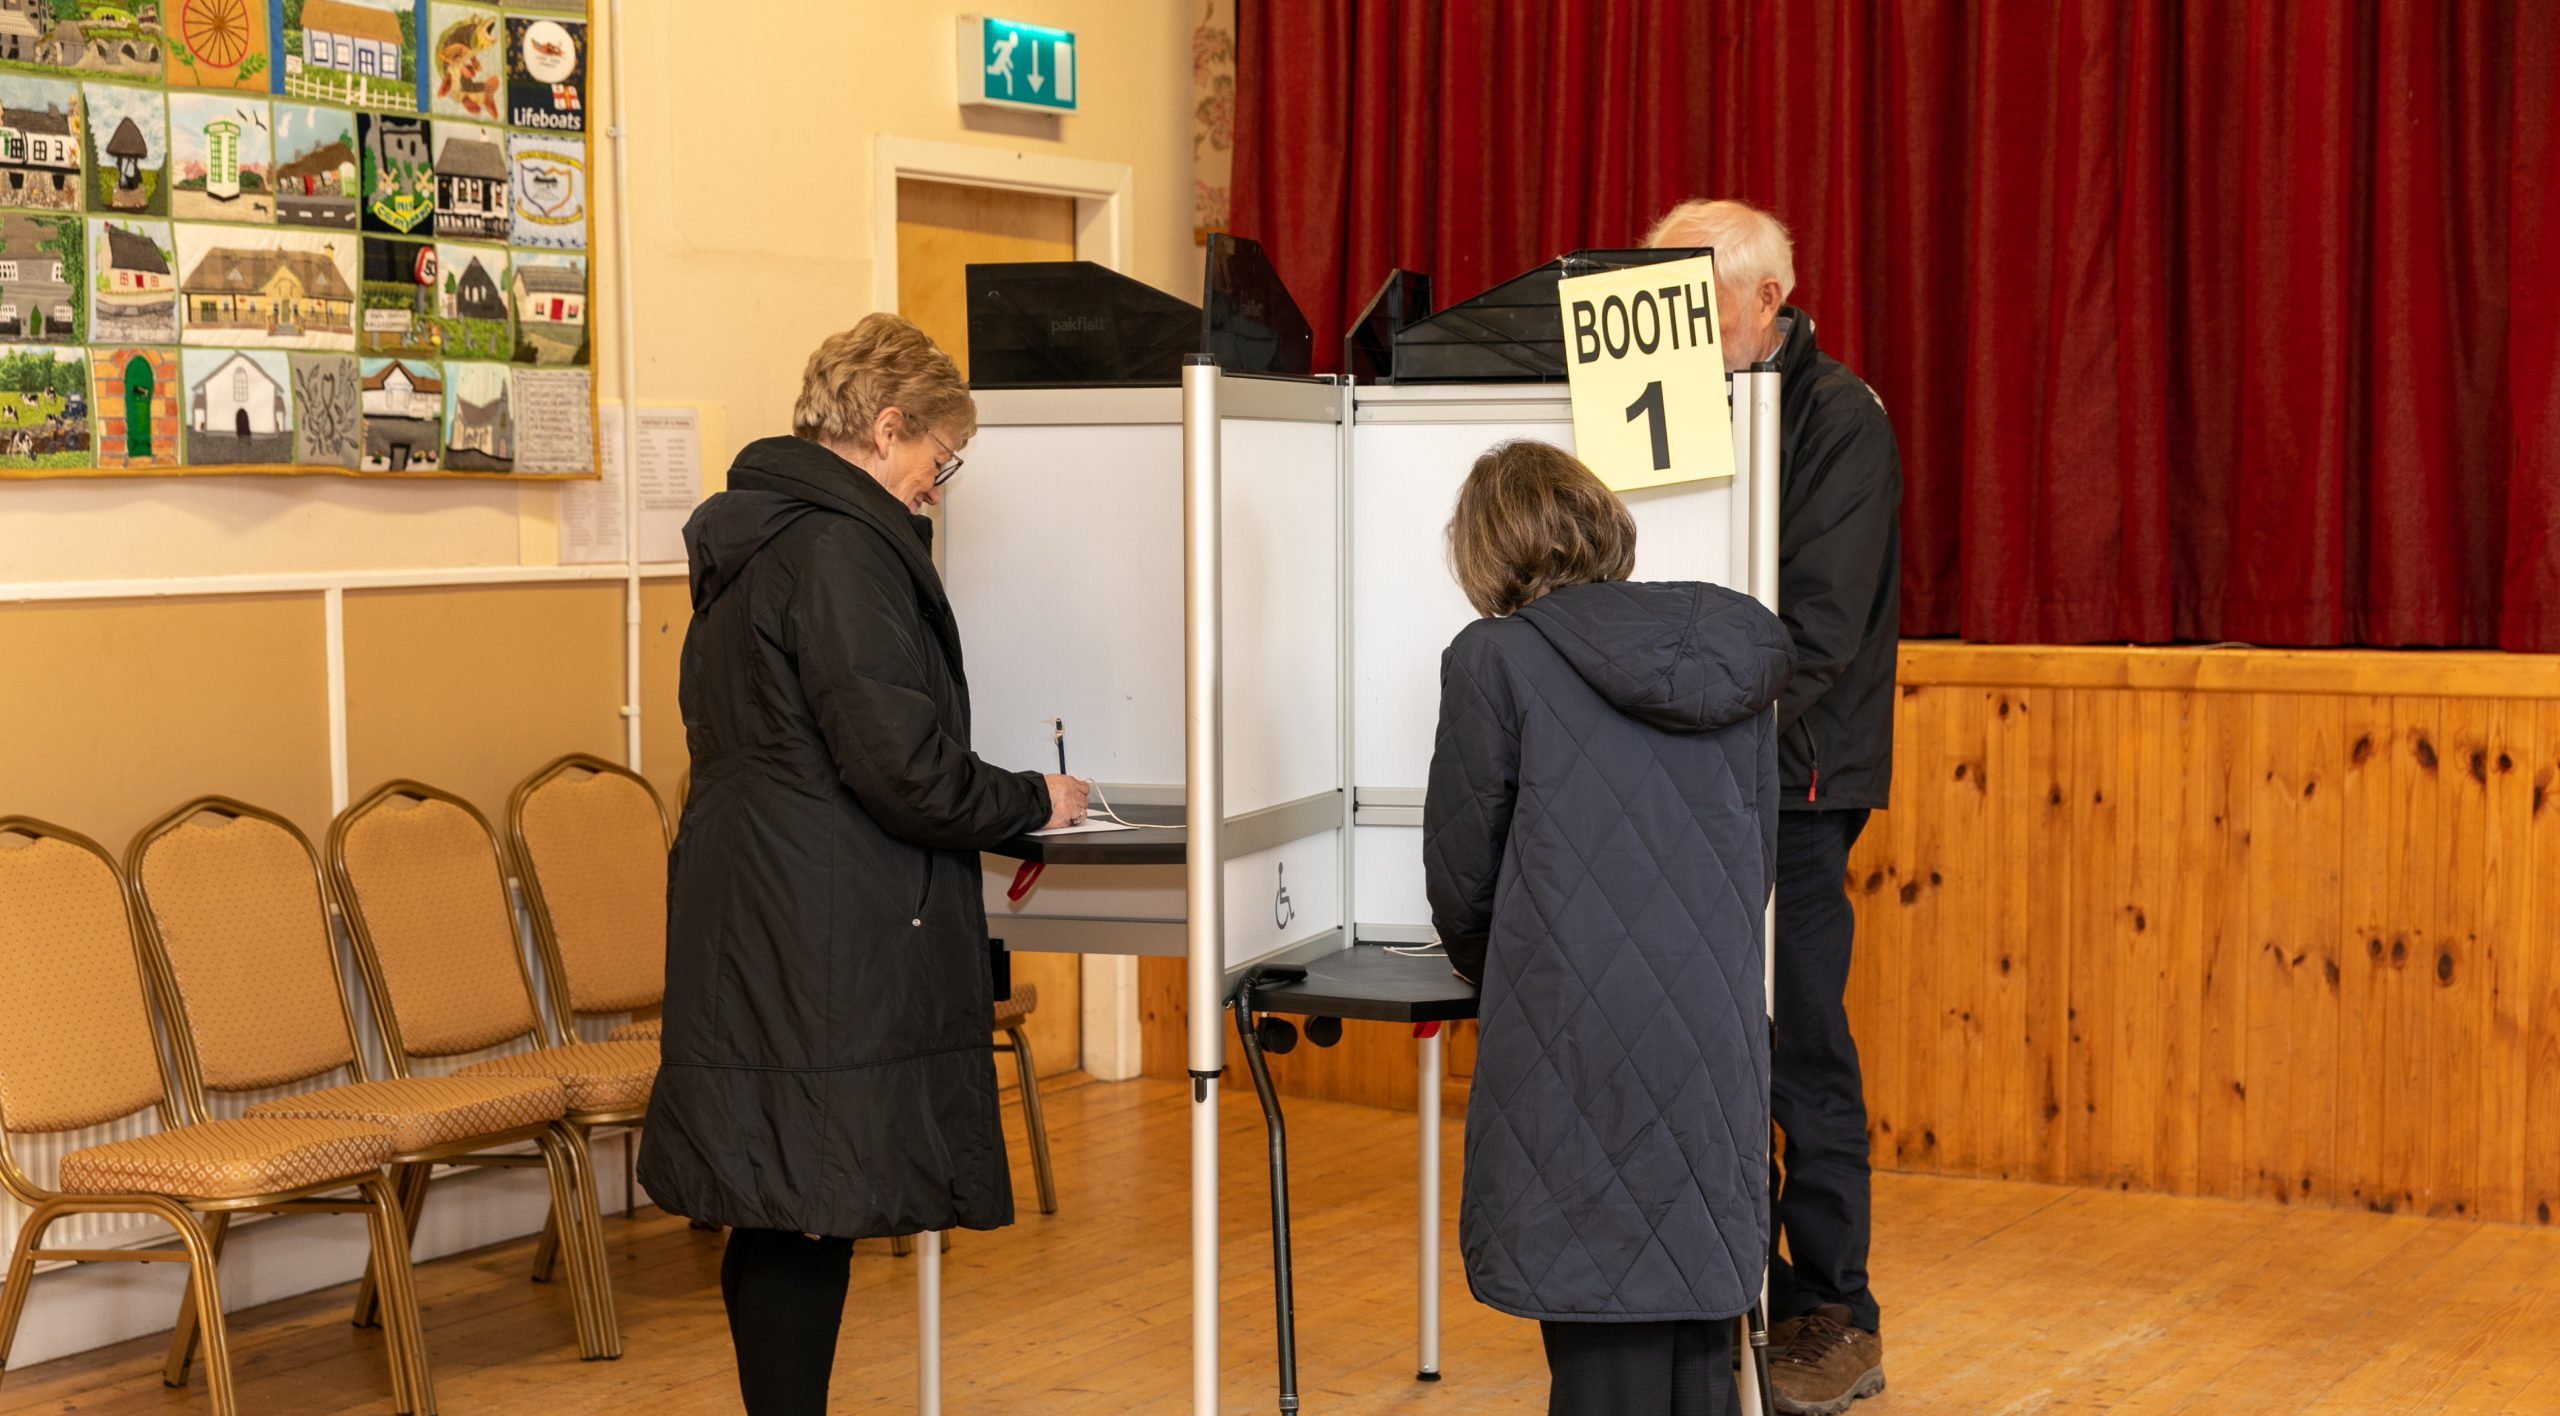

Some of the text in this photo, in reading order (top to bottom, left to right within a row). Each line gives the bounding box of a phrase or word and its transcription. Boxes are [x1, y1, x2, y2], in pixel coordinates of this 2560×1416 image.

[513, 107, 581, 130] Lifeboats
[1572, 281, 1714, 364] BOOTH
[1625, 380, 1671, 471] 1
